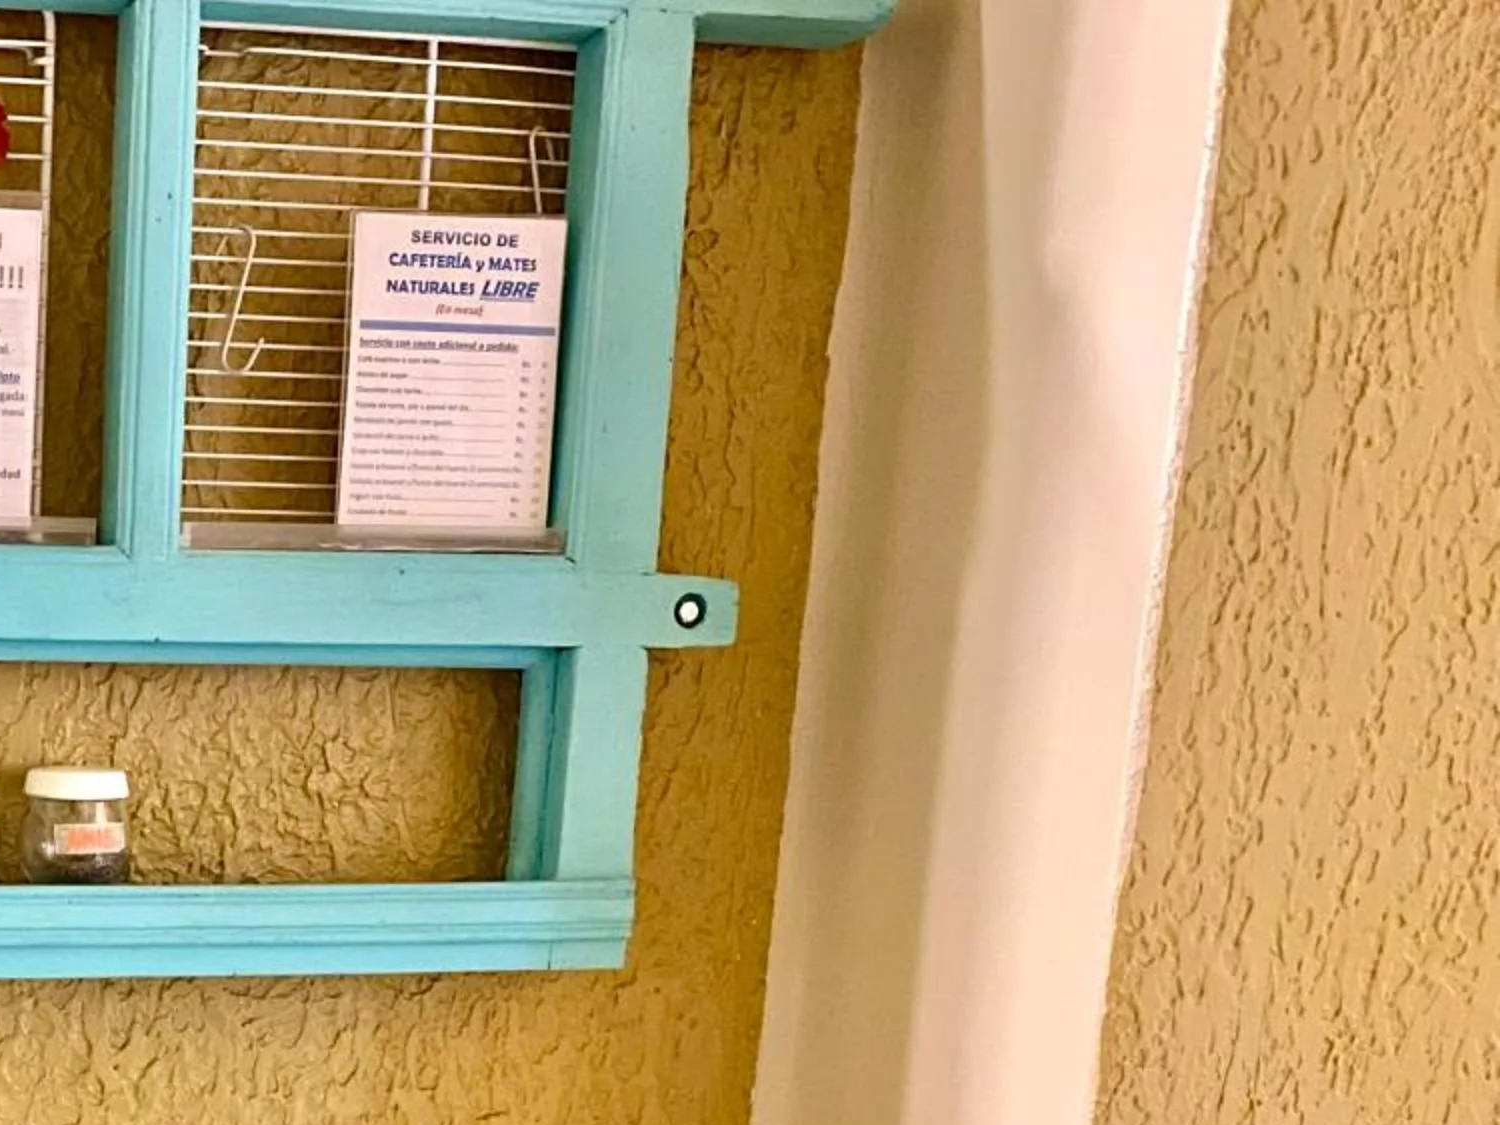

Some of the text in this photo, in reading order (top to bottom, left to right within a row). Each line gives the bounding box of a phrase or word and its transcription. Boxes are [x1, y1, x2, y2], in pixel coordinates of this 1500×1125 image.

[411, 230, 520, 248] SERVICIO DE
[389, 251, 537, 272] CAFETERÍA y MATES
[385, 279, 540, 299] NATURALES LIBRE
